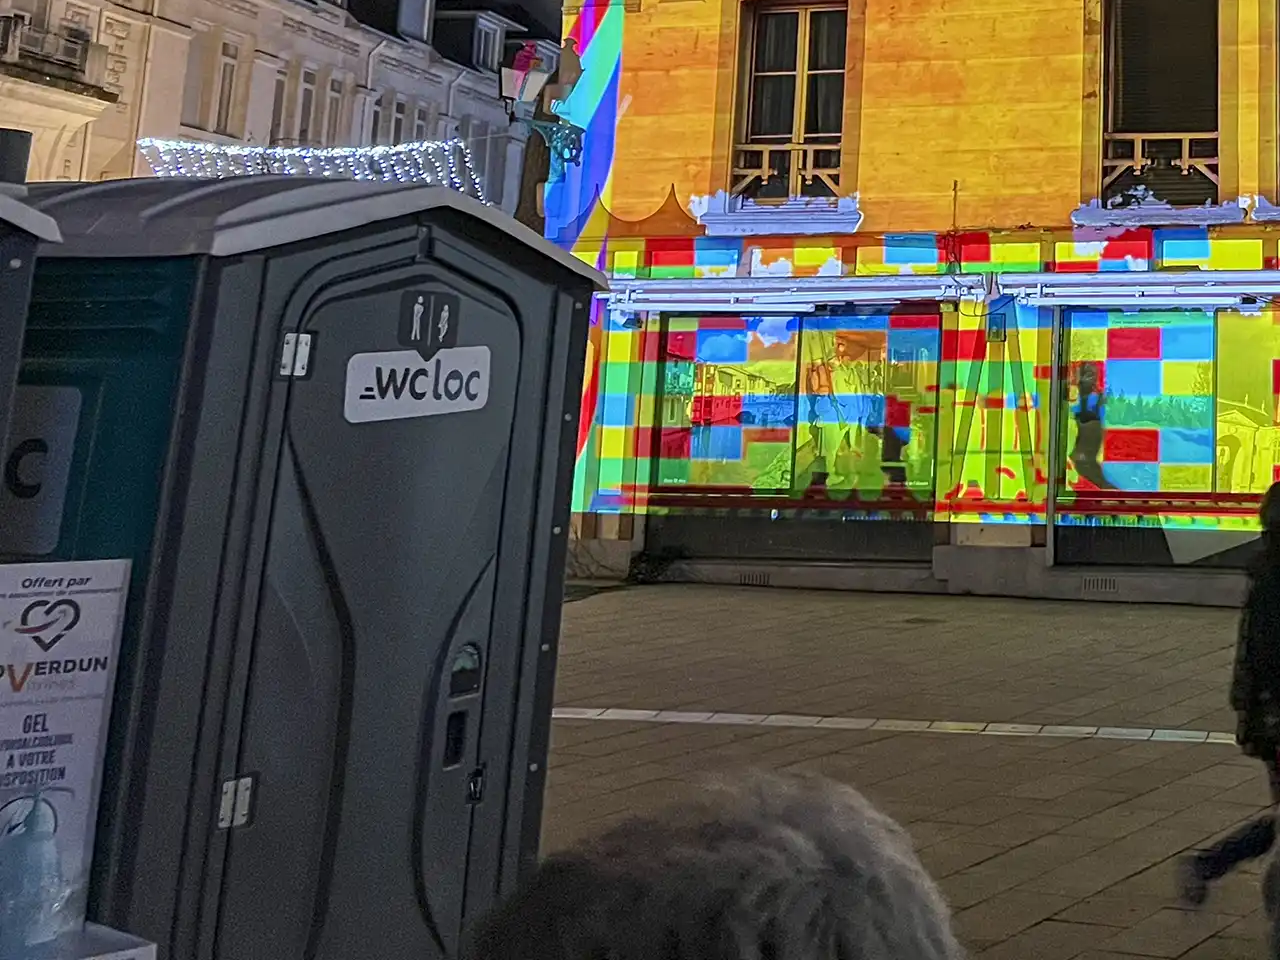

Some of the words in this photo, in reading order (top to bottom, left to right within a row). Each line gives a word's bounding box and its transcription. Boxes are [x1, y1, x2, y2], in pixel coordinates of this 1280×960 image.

[21, 577, 64, 589] Offert
[66, 577, 93, 589] par
[0, 656, 108, 693] VERDUN
[22, 713, 49, 734] GEL
